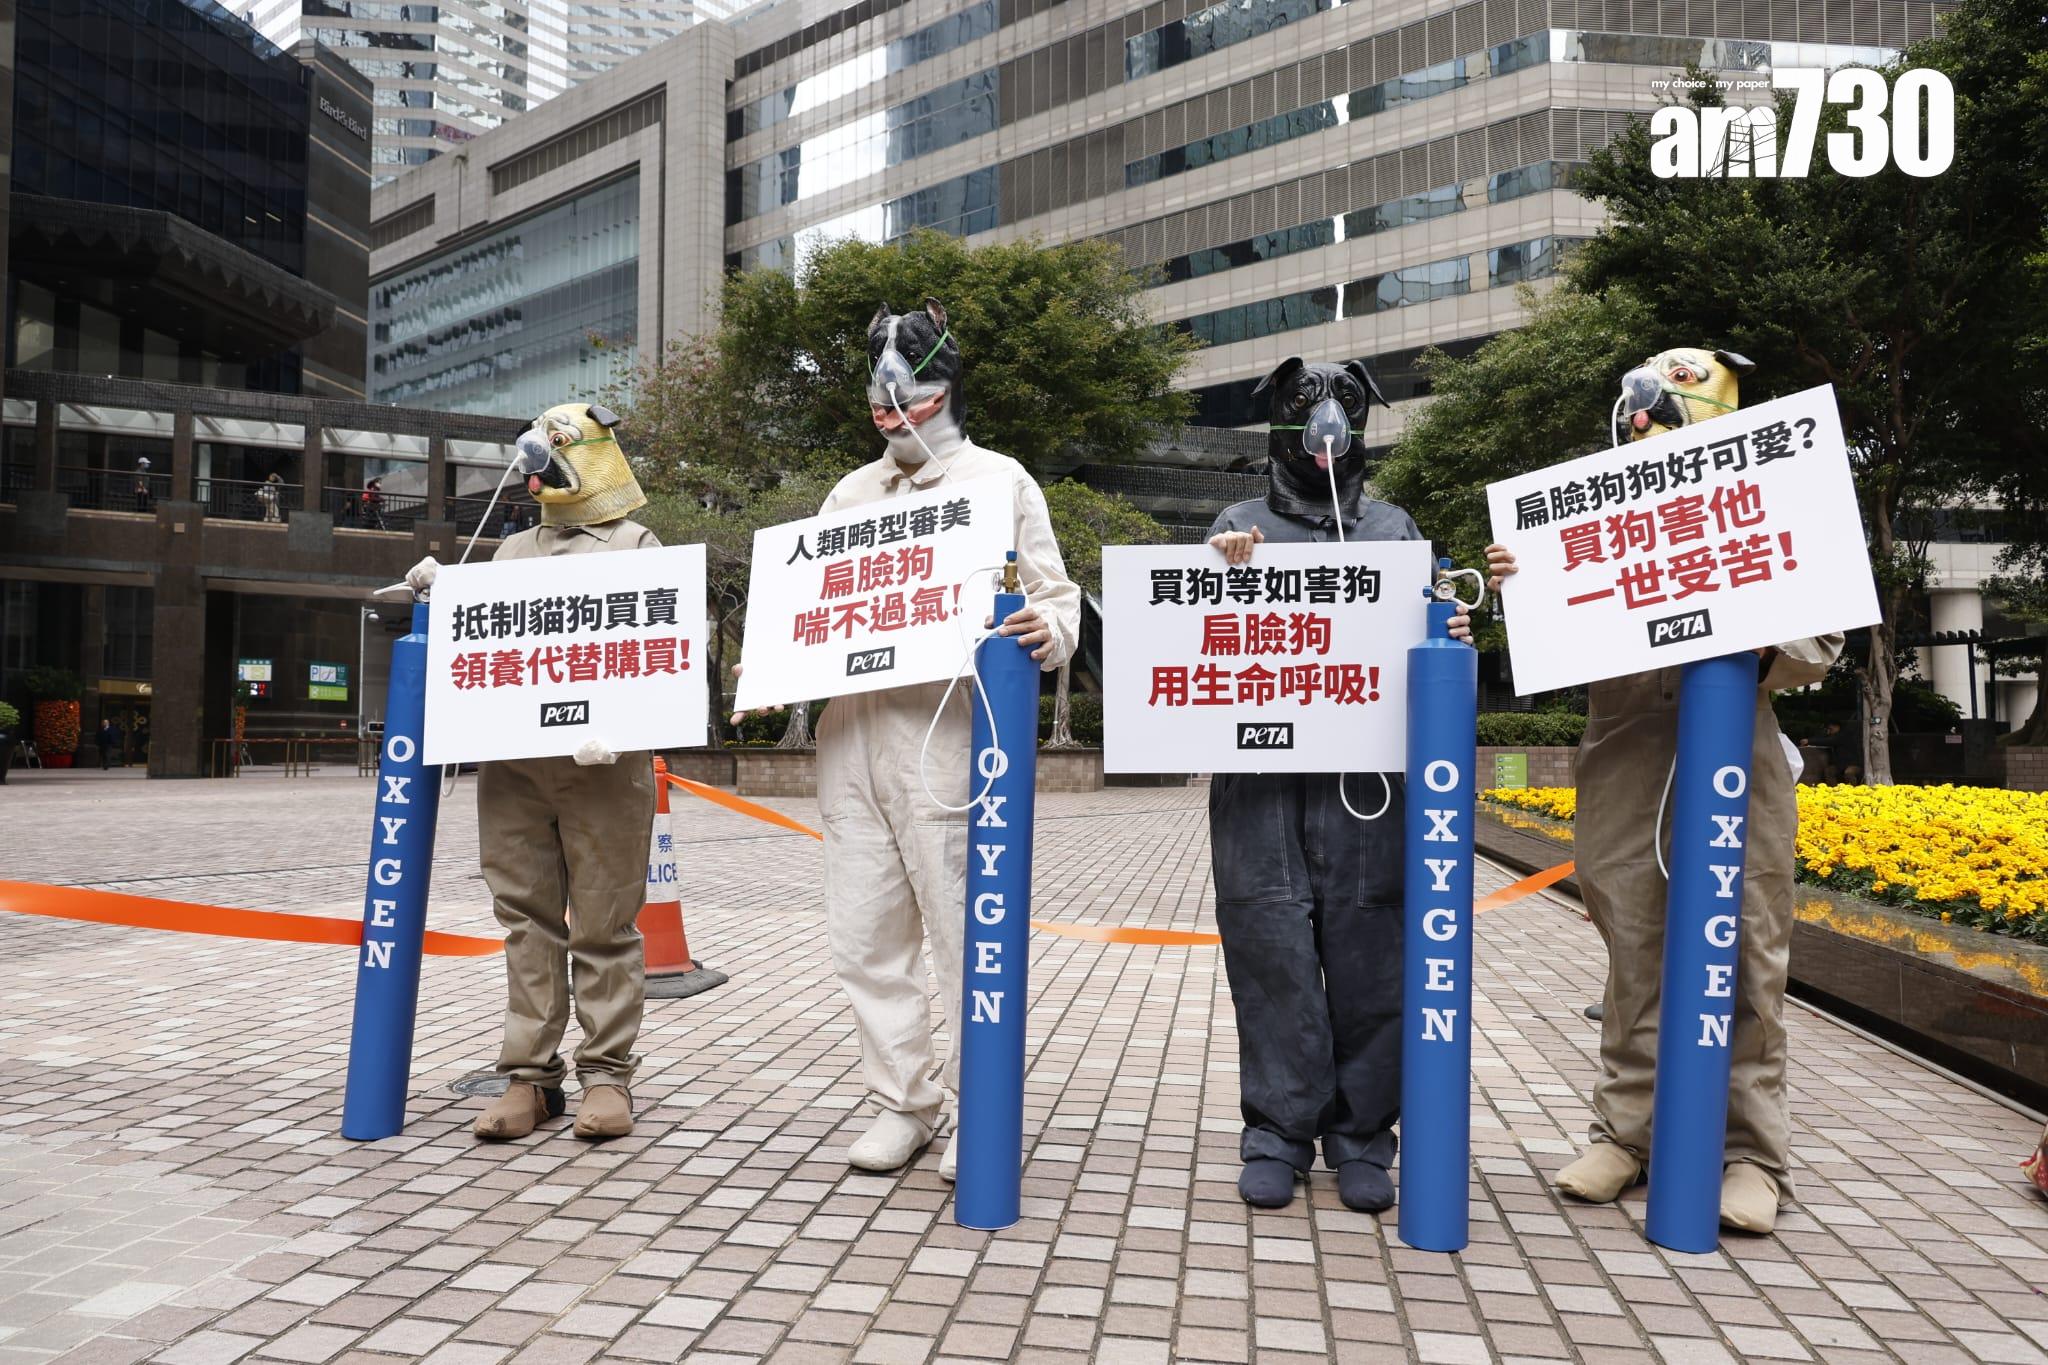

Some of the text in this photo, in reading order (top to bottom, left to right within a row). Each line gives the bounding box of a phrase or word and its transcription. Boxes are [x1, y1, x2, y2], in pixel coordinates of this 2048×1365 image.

[1515, 417, 1817, 531] 扁臉狗狗好可愛?
[786, 498, 971, 566] 人類畸型審美
[1559, 479, 1766, 572] 買狗害他
[819, 545, 934, 601] 扁臉狗
[1149, 565, 1381, 606] 買狗等如害狗
[1566, 530, 1799, 610] 一世受苦!
[452, 587, 679, 642] 抵制貓狗買賣
[793, 583, 963, 647] 喘不過氣!
[1200, 612, 1332, 656] 扁臉狗
[450, 637, 690, 690] 領養代替購買!
[1148, 663, 1381, 707] 用生命呼吸!
[365, 735, 416, 969] OXYGEN
[647, 863, 678, 883] LICE
[657, 833, 673, 853] 察
[971, 746, 1009, 1024] OXYGEN
[1422, 760, 1460, 1042] OXYGEN
[1698, 765, 1747, 1047] OXYGEN
